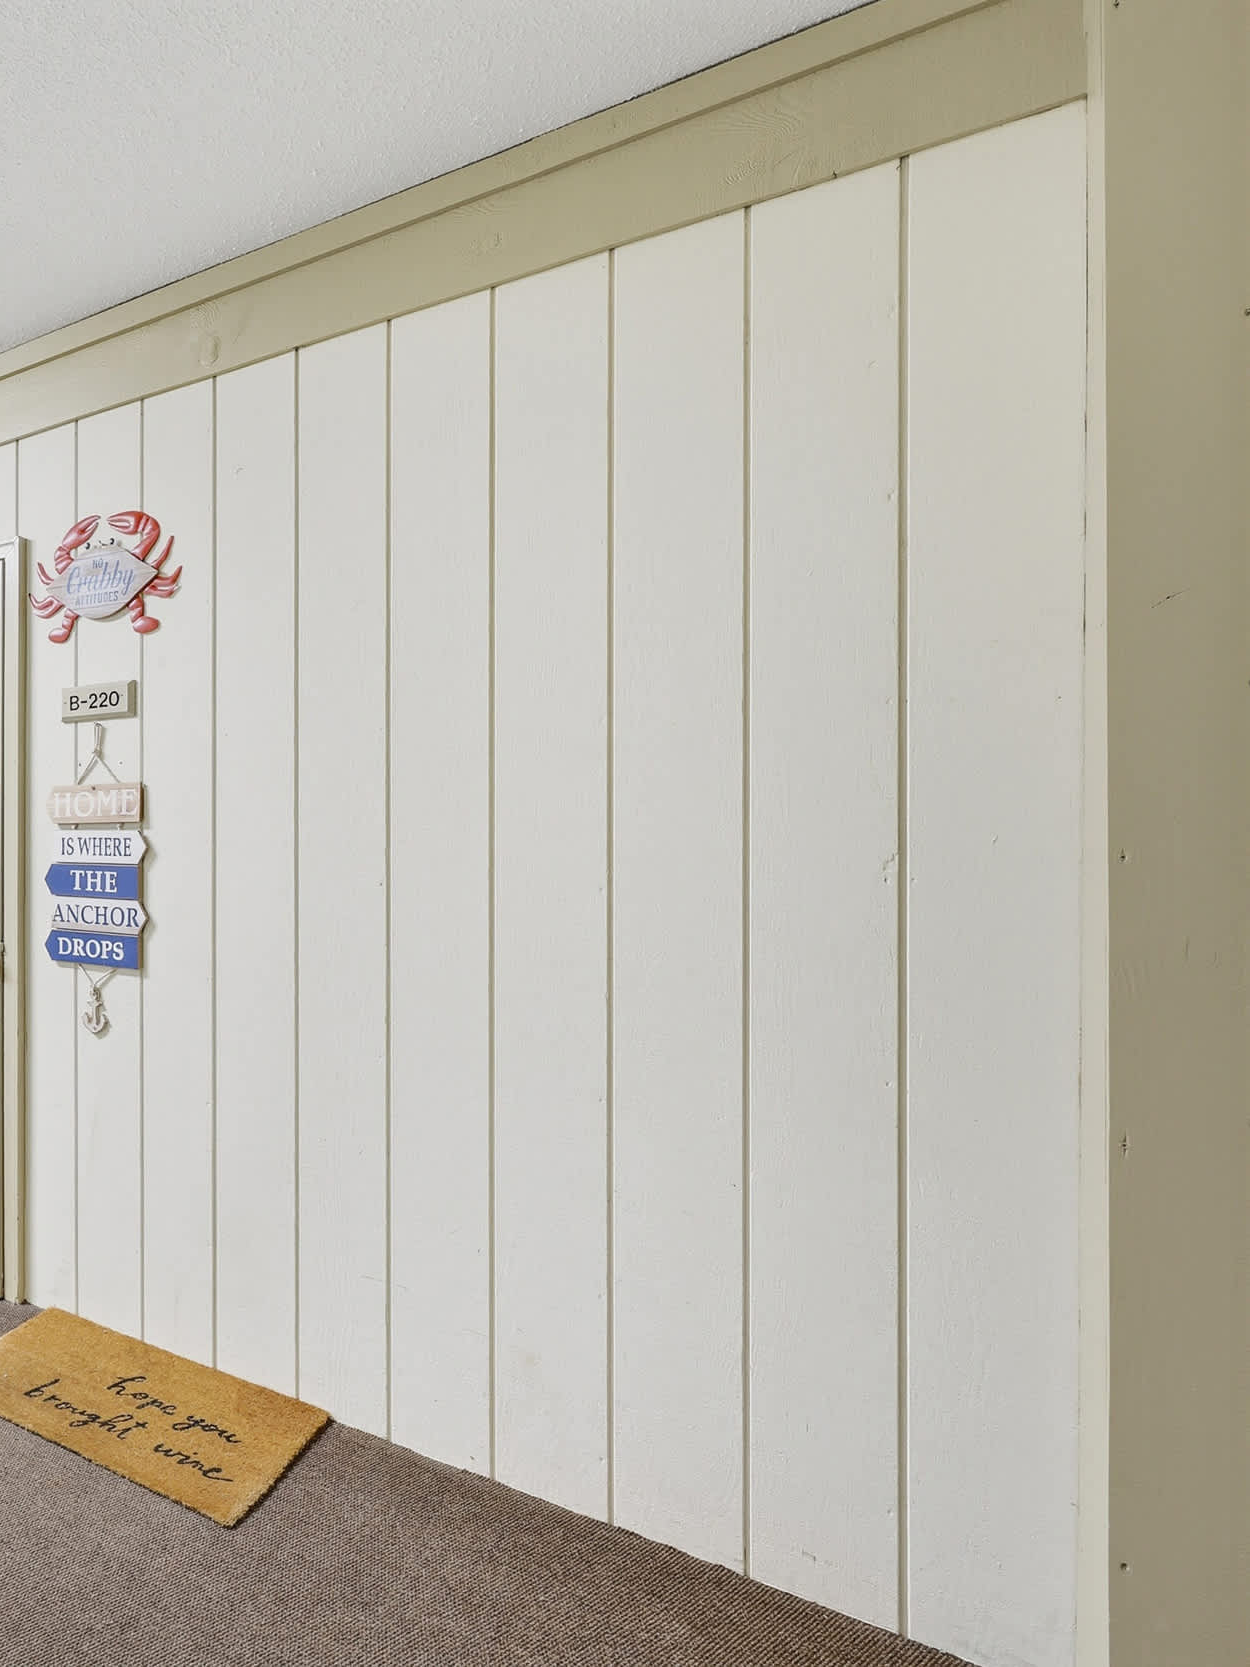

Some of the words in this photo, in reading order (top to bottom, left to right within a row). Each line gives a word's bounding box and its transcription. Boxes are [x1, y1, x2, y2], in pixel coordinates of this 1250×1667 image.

[67, 560, 134, 596] Crabby
[75, 591, 118, 606] ATTITUDES
[70, 691, 119, 711] B-220
[53, 789, 138, 818] HOME
[61, 837, 75, 855] IS
[77, 837, 131, 857] WHERE
[70, 869, 117, 893] THE
[52, 903, 139, 928] ANCHOR
[57, 936, 124, 961] DROPS
[107, 1376, 176, 1415] hope
[172, 1415, 242, 1444] you
[24, 1378, 148, 1440] brought
[154, 1442, 233, 1482] wine
